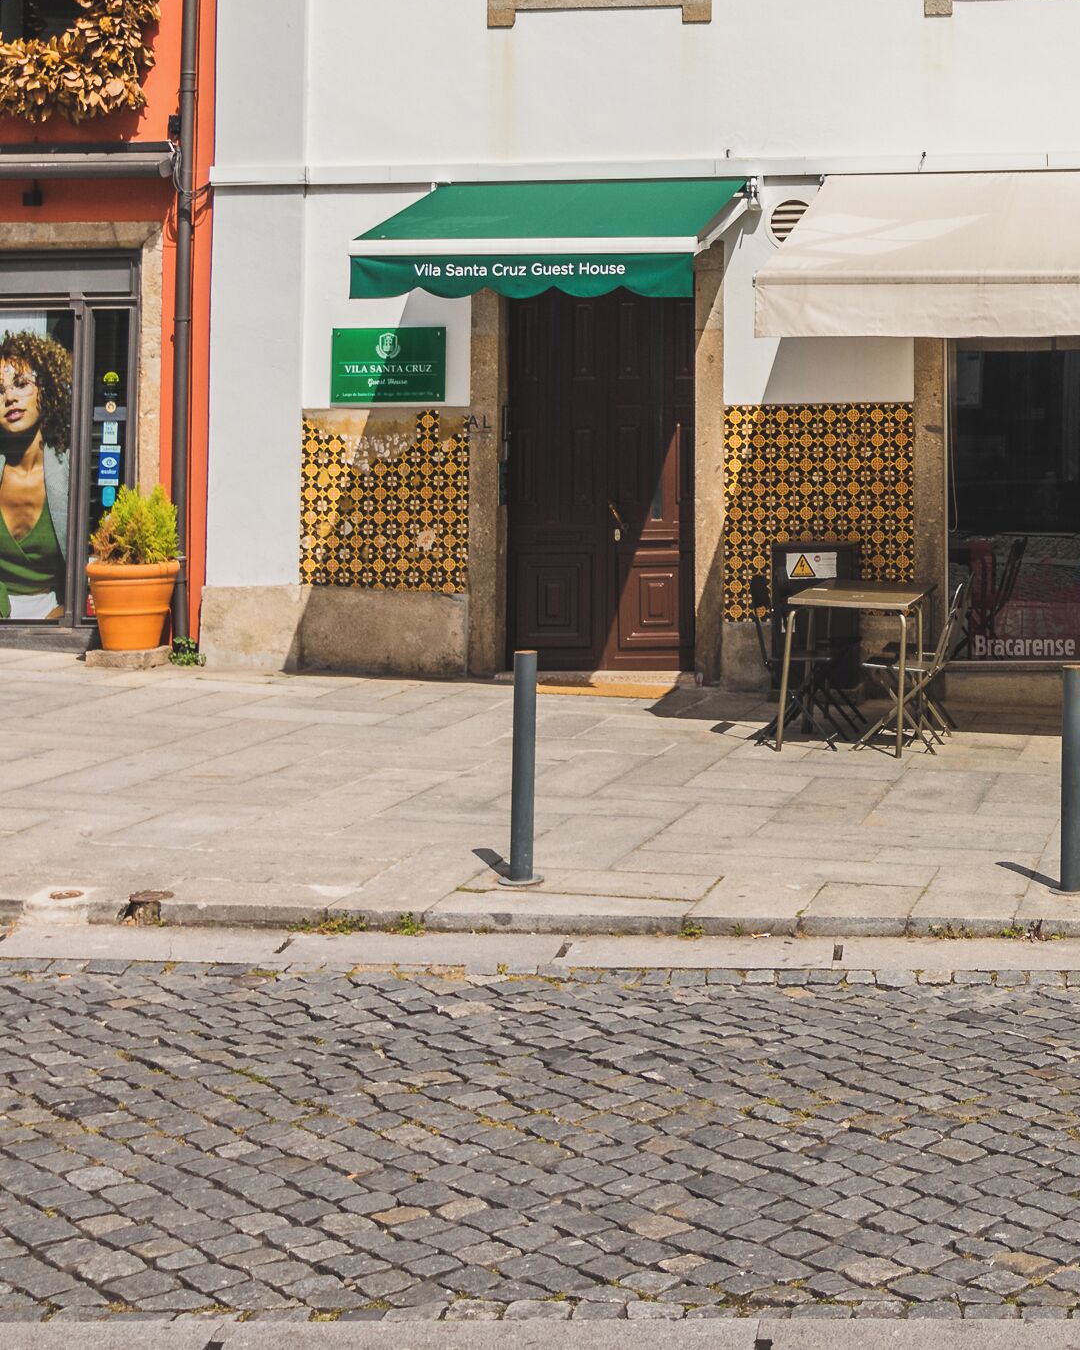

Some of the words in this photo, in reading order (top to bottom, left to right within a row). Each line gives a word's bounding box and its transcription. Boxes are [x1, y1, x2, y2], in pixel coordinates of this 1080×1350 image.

[414, 263, 441, 276] Vila
[445, 263, 488, 276] Santa
[492, 263, 526, 276] Cruz
[531, 262, 575, 276] Guest
[579, 262, 625, 275] House
[344, 364, 368, 374] VILA
[369, 364, 404, 373] SANTA
[405, 364, 432, 373] CRUZ
[367, 377, 386, 387] Guest
[469, 414, 492, 429] AL
[975, 634, 1076, 656] Bracarense
